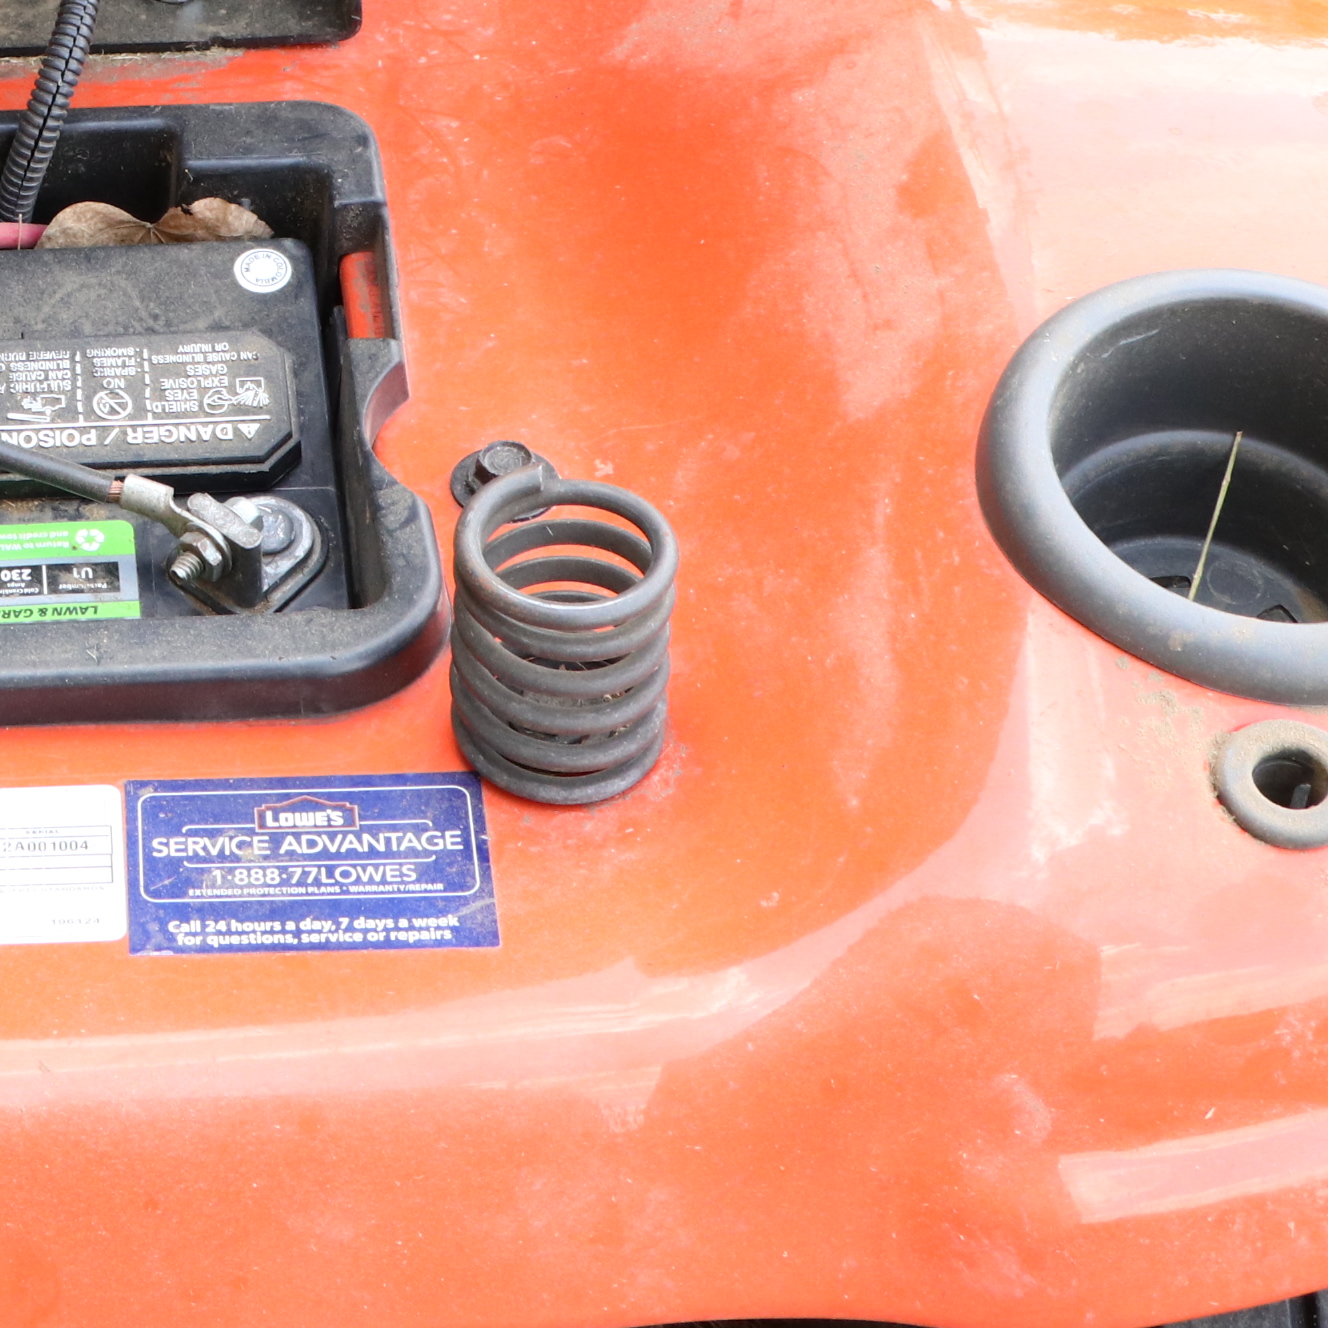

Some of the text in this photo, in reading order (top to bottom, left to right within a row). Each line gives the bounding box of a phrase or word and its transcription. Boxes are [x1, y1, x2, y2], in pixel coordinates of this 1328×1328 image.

[244, 254, 260, 273] MADE
[86, 347, 136, 357] SMOKING
[178, 342, 229, 353] OR INJURY
[93, 356, 136, 367] FLAMES
[151, 353, 204, 364] BLINDNESS
[206, 352, 238, 362] CAUSE
[10, 360, 71, 371] BLINDNESS
[186, 364, 228, 376] GASES
[48, 370, 72, 380] CAN
[10, 380, 72, 393] SULFURIC
[103, 378, 125, 388] NO
[160, 376, 229, 389] EXPLOSIVE
[165, 390, 198, 400] EYES
[153, 401, 199, 412] SHIELD
[0, 424, 234, 449] DANGER POISON
[19, 532, 48, 540] credit
[50, 530, 69, 538] and
[35, 540, 70, 548] Return
[0, 569, 32, 581] 230
[72, 567, 92, 579] U1
[37, 607, 48, 617] &
[51, 605, 99, 616] LAWN
[265, 809, 344, 827] LOWE'S
[152, 830, 464, 857] SERVICE ADVANTAGE
[188, 883, 444, 897] EXTENDED PROTECTION PLANS WARRANTY/REPAIR
[168, 914, 460, 933] Call 24 hours a day, 7 days a week
[176, 928, 453, 948] for questions, service or repairs
